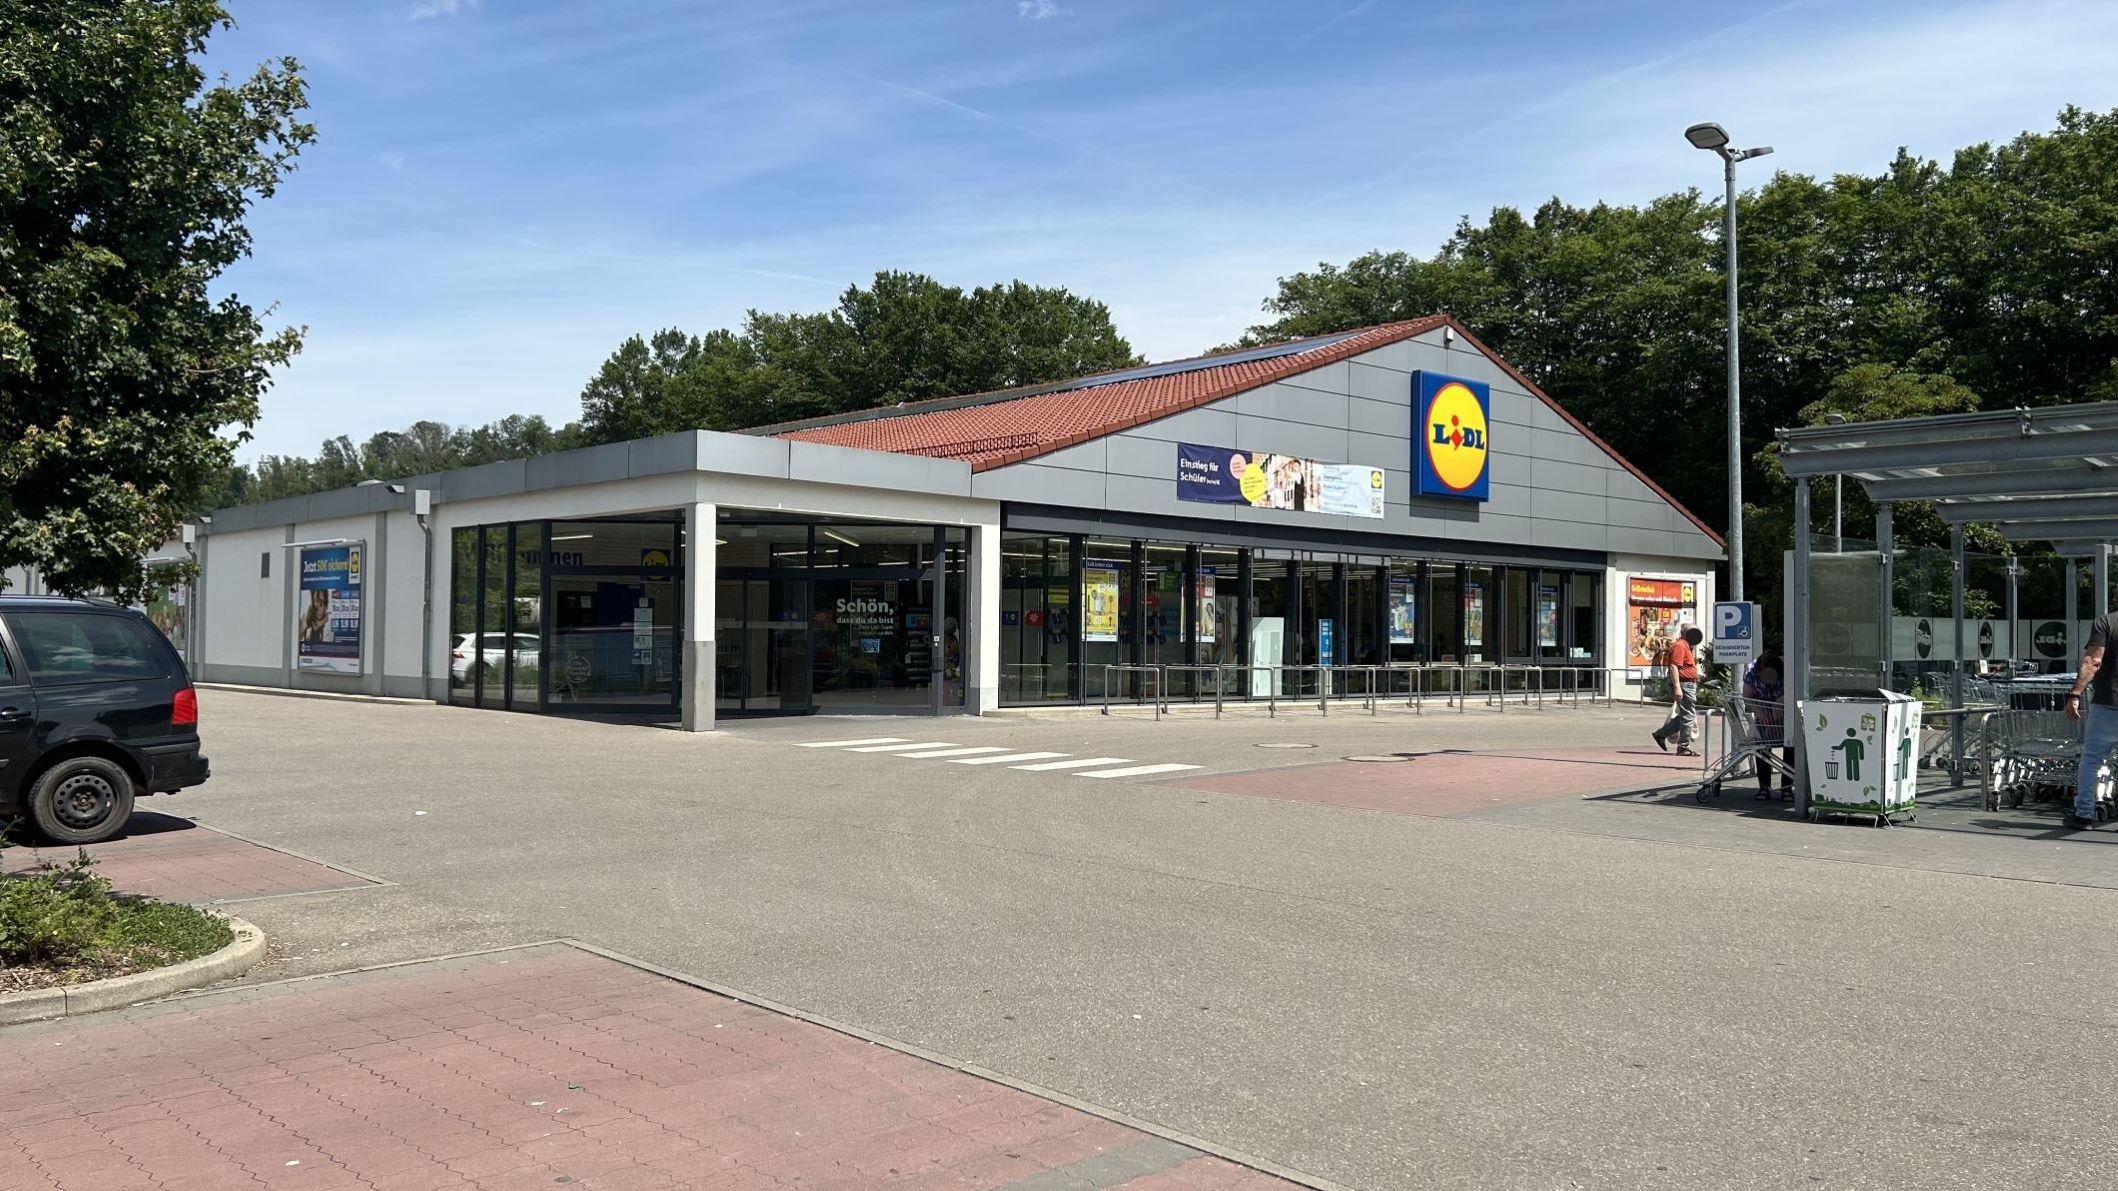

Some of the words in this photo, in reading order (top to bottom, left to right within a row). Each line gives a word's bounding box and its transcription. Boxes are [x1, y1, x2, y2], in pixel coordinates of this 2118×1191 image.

[1180, 458, 1209, 473] Einstieg
[1209, 461, 1219, 472] für
[1180, 471, 1207, 482] Schüler
[303, 560, 317, 573] Jetzt
[836, 598, 894, 616] Schön,
[836, 616, 854, 624] dass
[855, 616, 867, 624] du
[867, 616, 878, 624] da
[878, 616, 894, 624] bist
[1716, 605, 1743, 639] P
